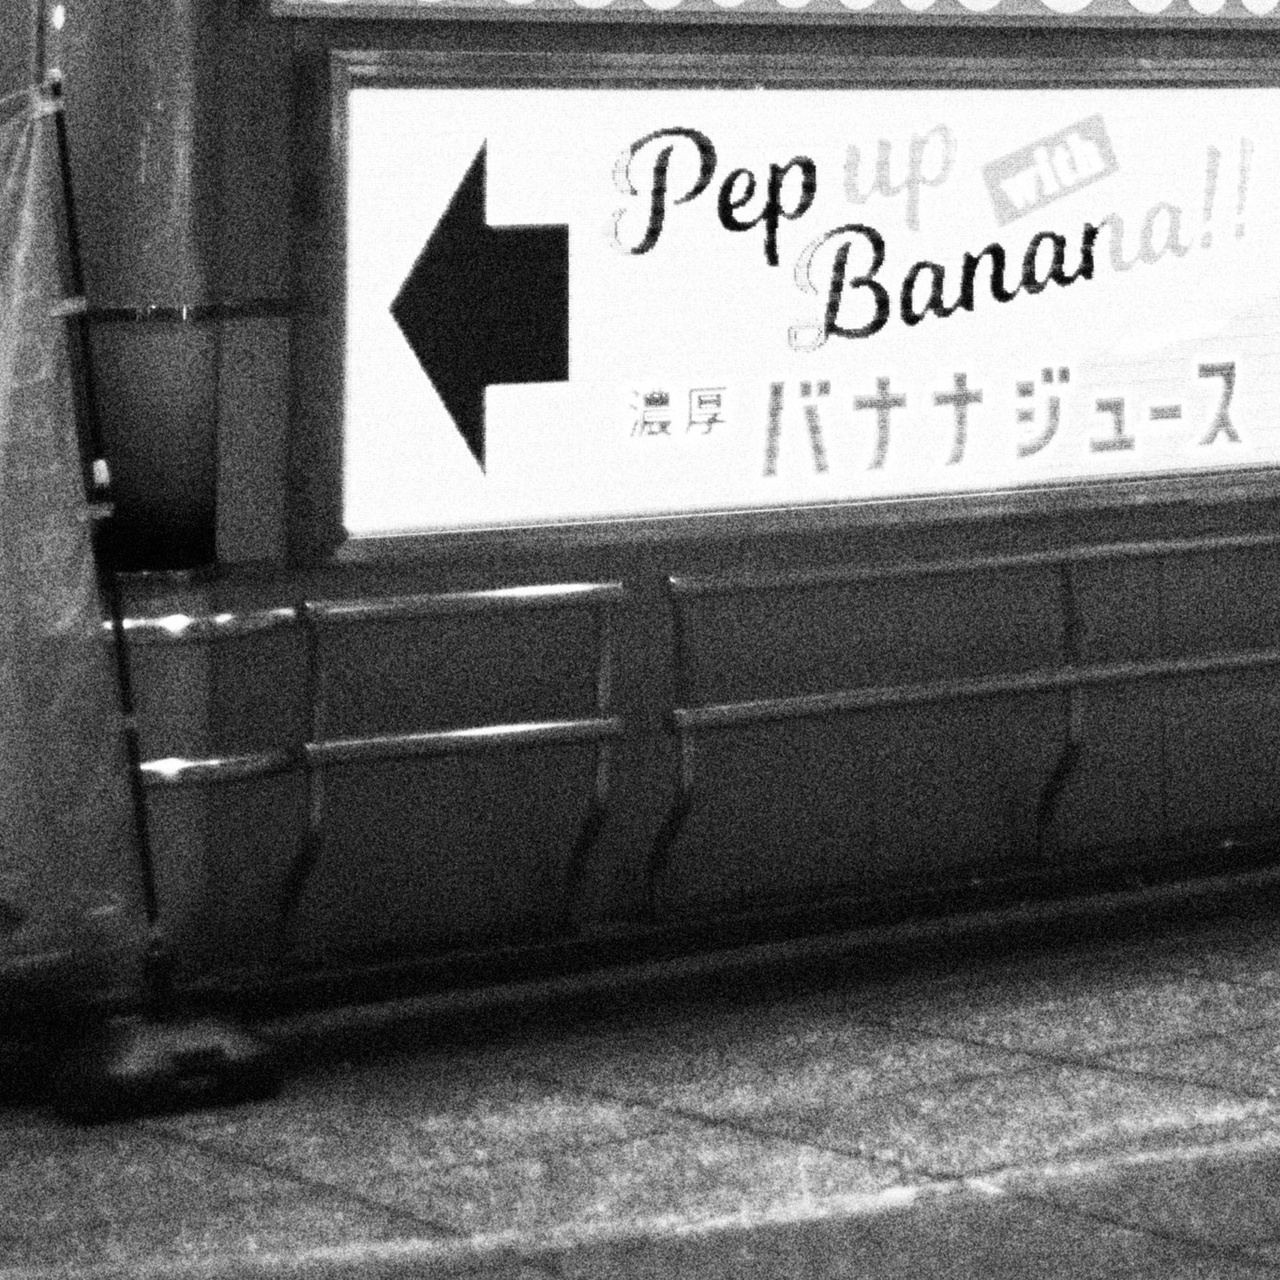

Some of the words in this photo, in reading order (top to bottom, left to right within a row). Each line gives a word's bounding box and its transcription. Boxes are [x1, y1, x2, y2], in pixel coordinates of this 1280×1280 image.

[610, 126, 818, 267] Pep
[843, 122, 958, 231] up
[999, 131, 1107, 211] with
[787, 138, 1255, 353] Banana!!
[629, 384, 728, 438] 濃厚
[762, 361, 1242, 477] バナナジュース
